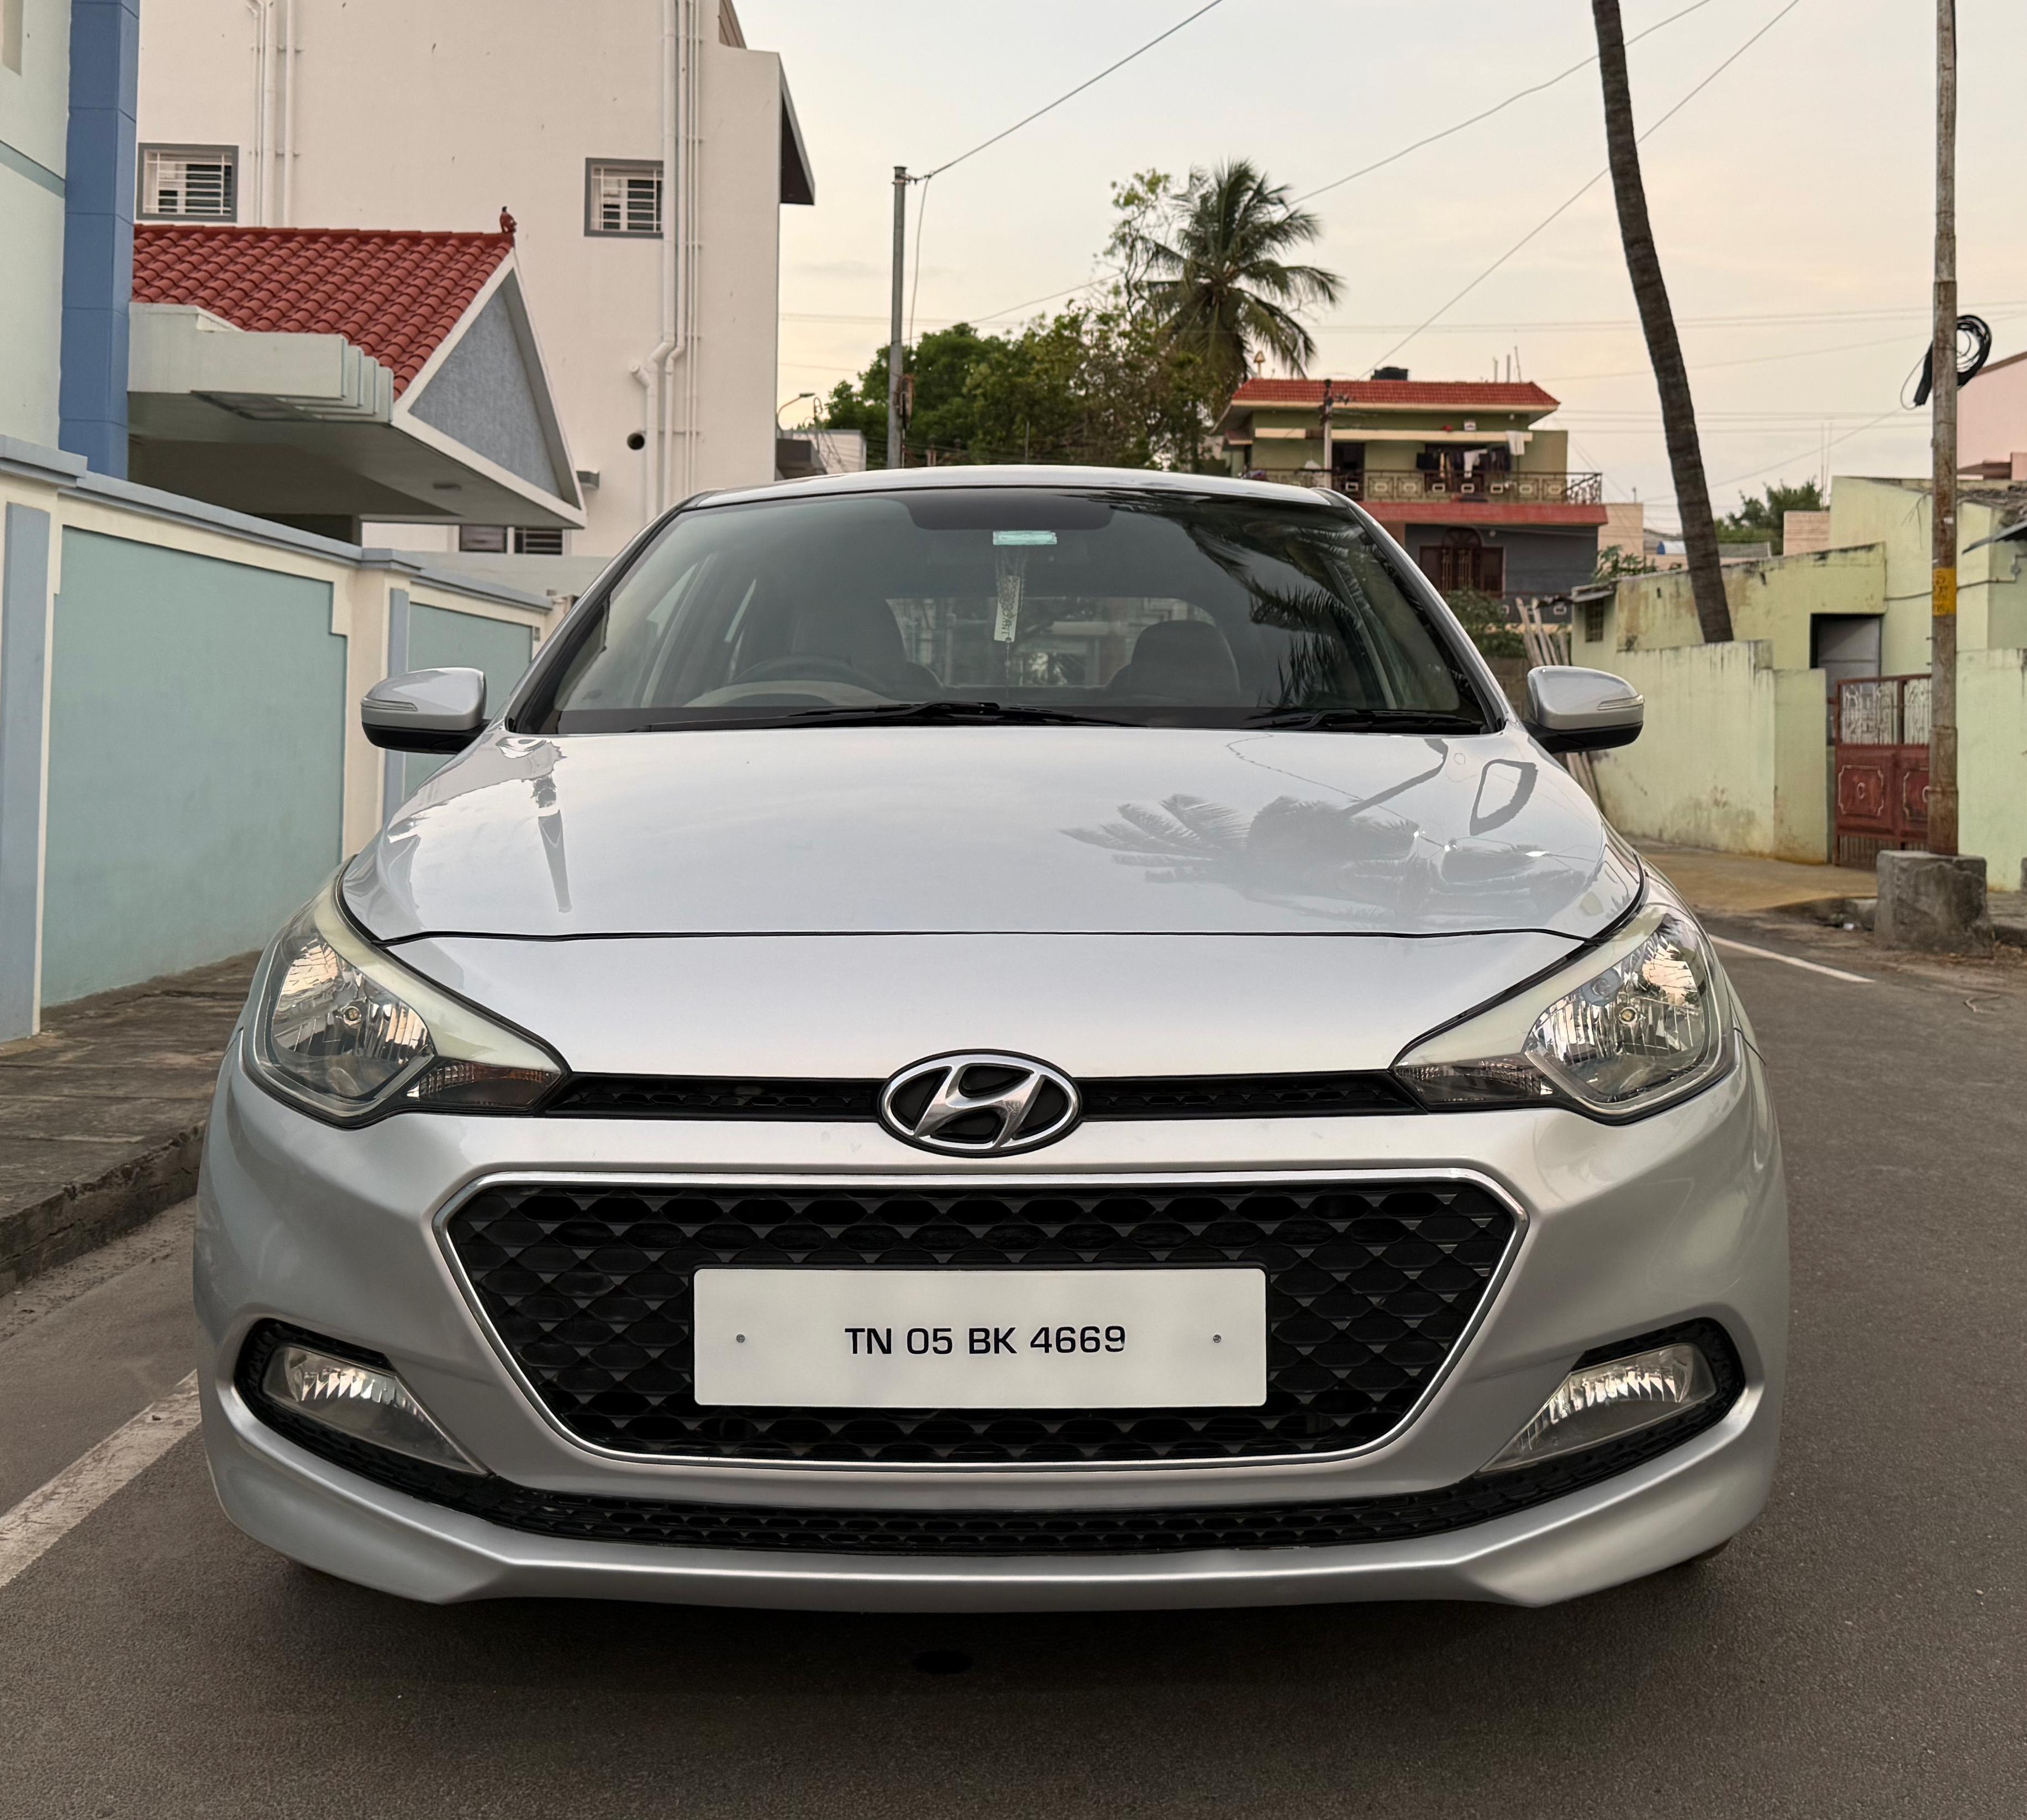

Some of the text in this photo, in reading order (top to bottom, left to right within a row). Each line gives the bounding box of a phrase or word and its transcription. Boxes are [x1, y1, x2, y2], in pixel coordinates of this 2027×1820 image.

[844, 1325, 1125, 1354] TN 05 BK 4669
